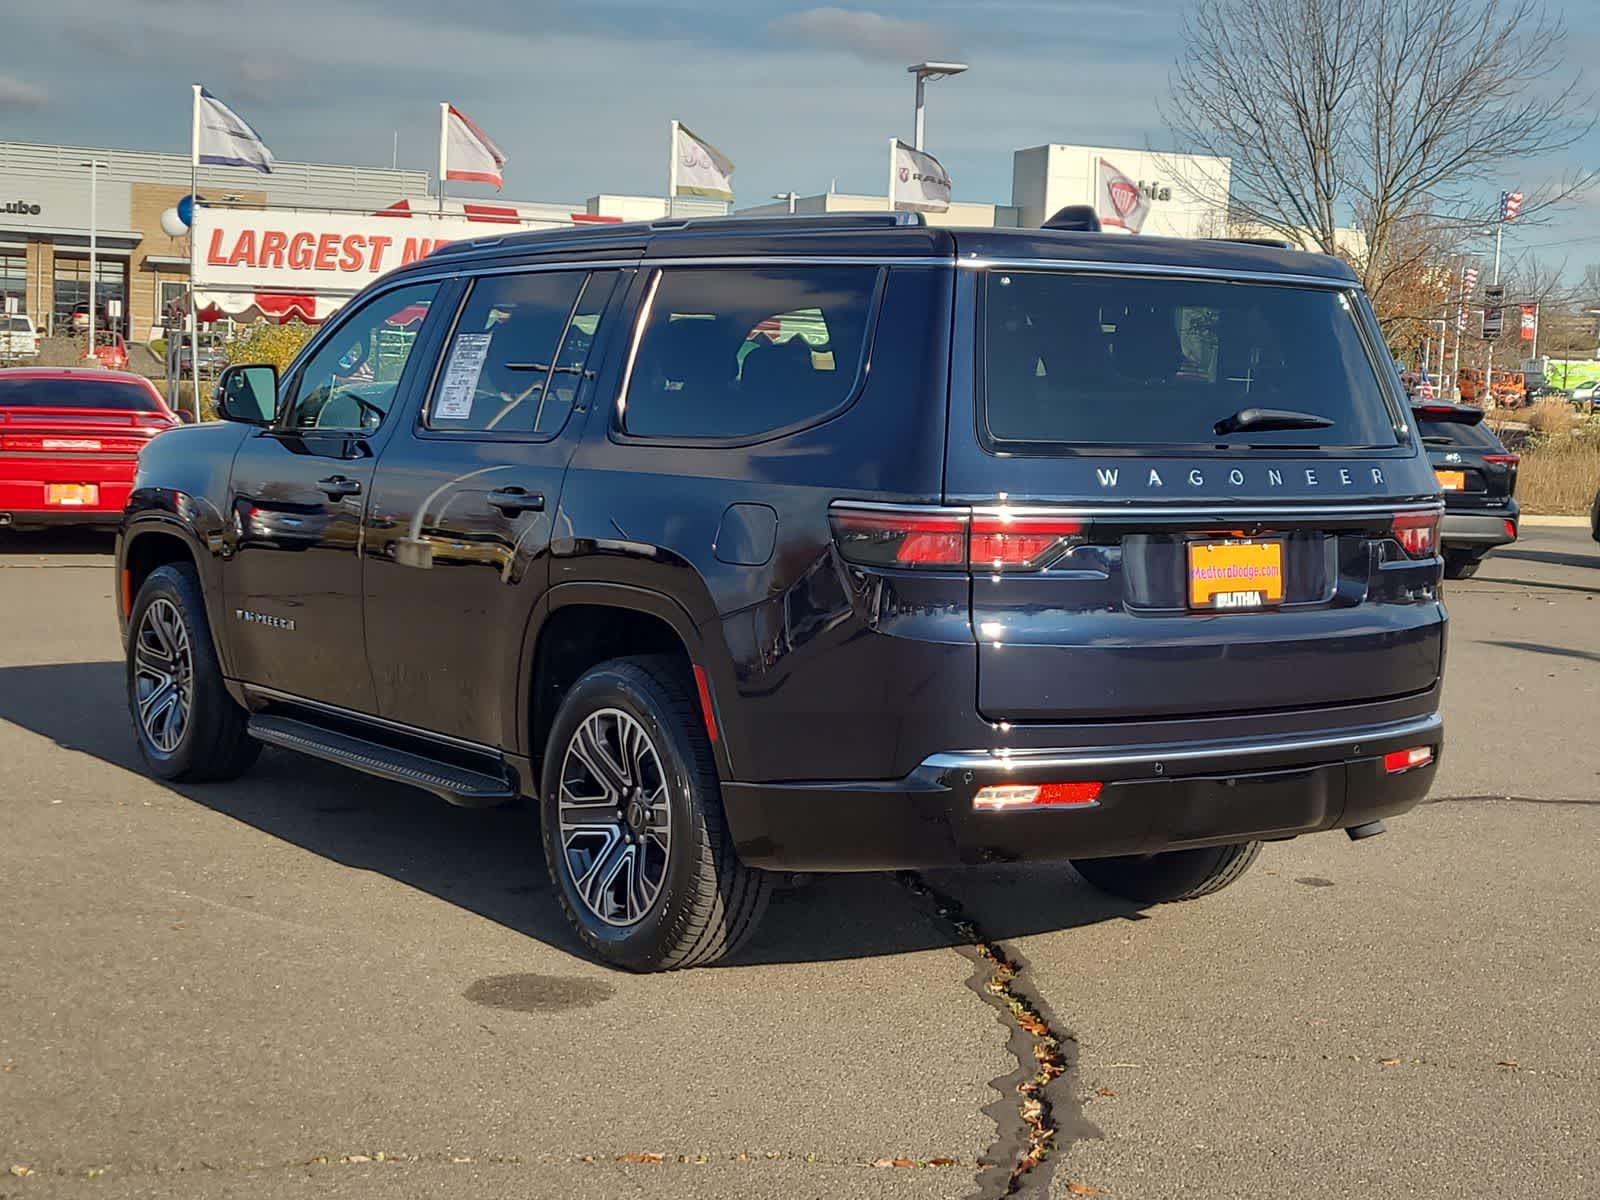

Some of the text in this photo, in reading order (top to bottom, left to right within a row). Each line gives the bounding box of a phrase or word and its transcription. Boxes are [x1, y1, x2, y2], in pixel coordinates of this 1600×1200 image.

[207, 228, 393, 273] LARGEST
[1096, 467, 1385, 487] WAGONEER
[1192, 564, 1279, 581] MedfordDodge.com
